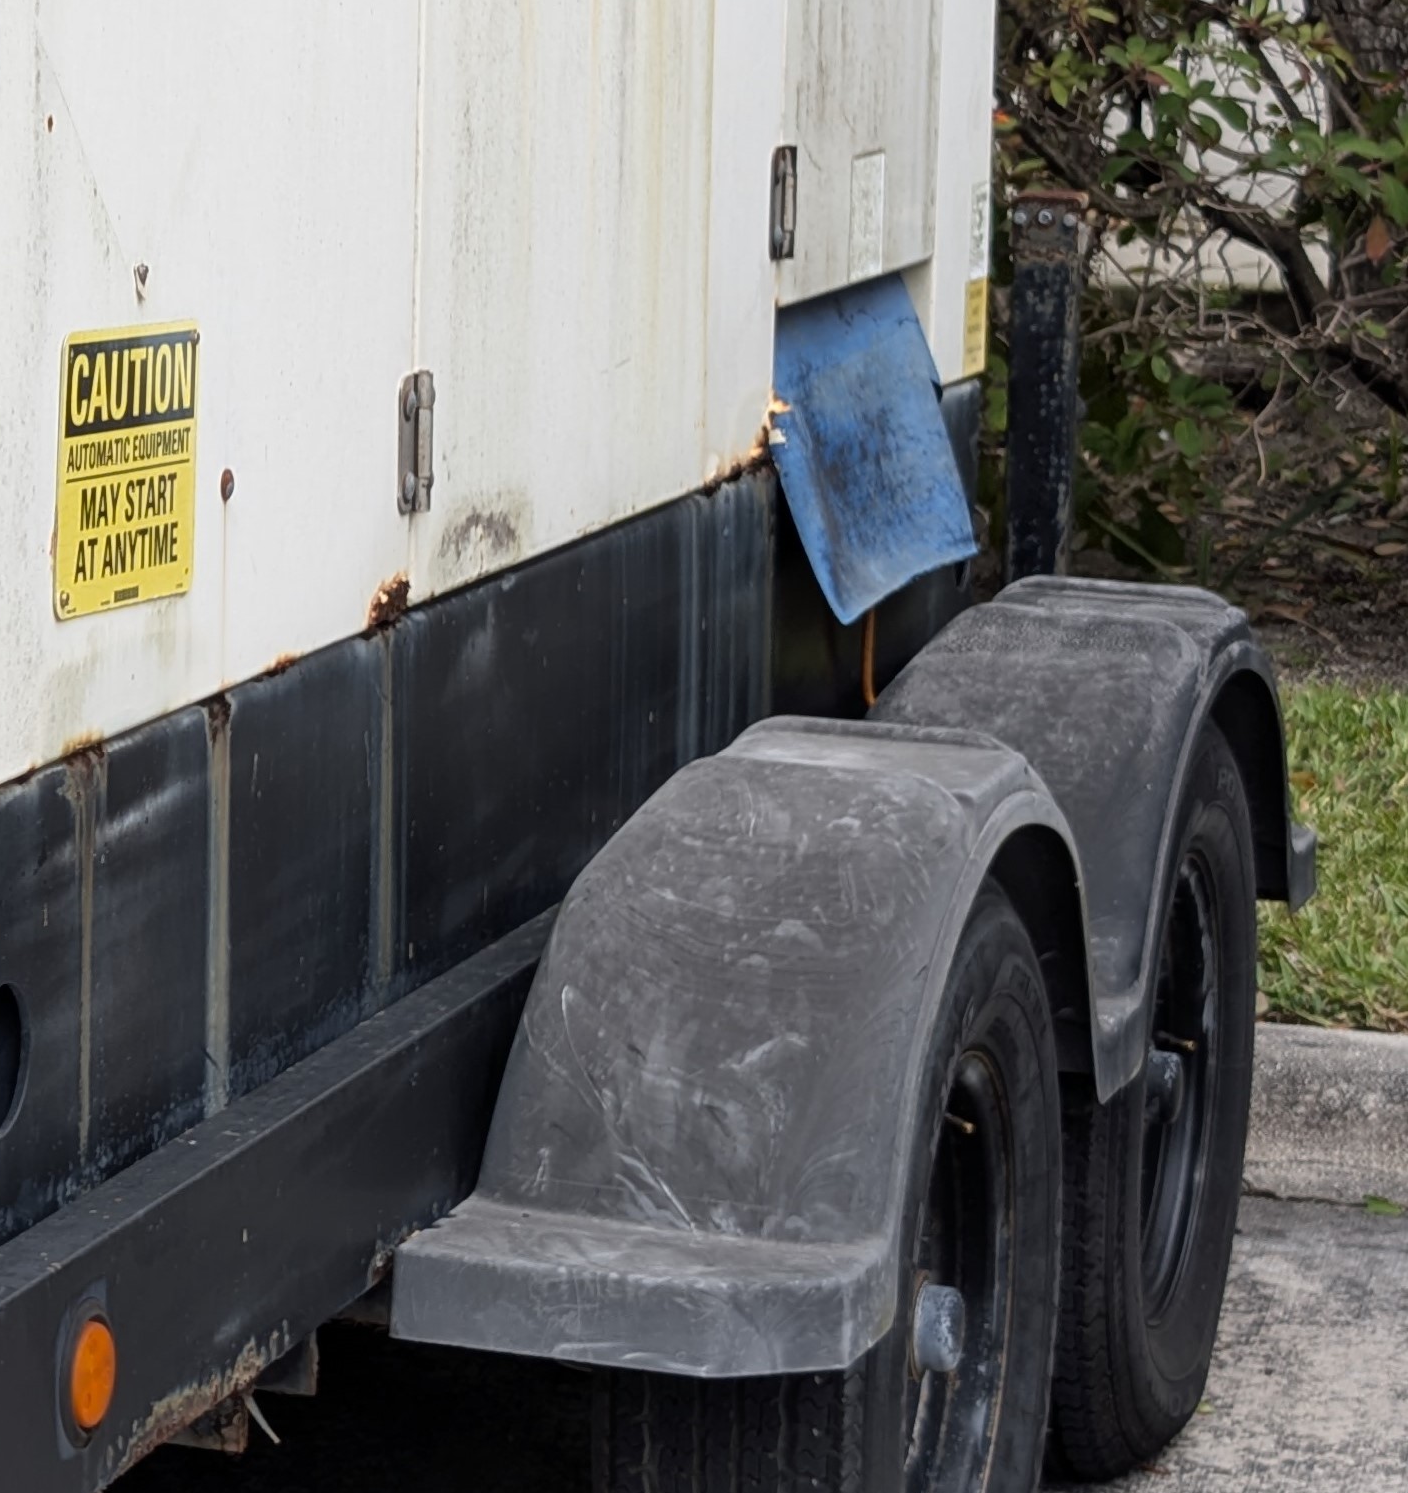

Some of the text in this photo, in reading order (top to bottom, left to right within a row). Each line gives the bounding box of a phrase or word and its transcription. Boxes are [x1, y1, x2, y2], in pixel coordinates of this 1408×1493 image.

[70, 341, 192, 427] CAUTION
[66, 426, 191, 474] AUTOMATIC EQUIPMENT
[80, 472, 177, 532] MAY START
[74, 522, 179, 585] AT ANYTIME
